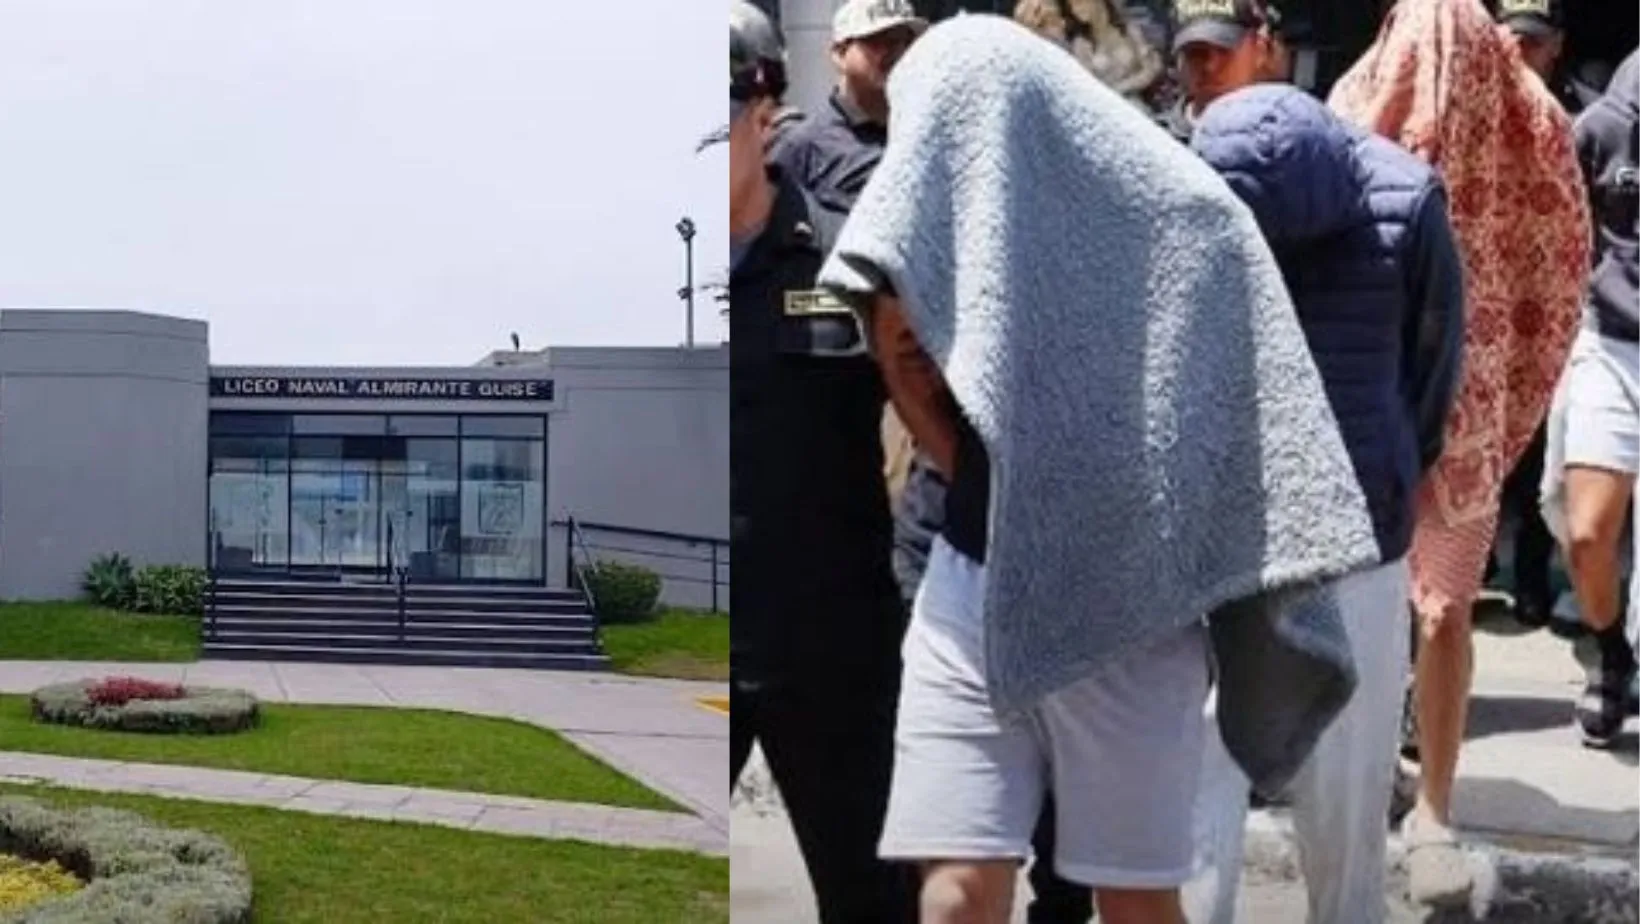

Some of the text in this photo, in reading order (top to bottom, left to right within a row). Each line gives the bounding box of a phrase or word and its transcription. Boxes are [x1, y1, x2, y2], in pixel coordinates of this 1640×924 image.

[224, 379, 279, 393] LICEO
[288, 380, 348, 394] NAVAL
[357, 381, 472, 396] ALMIRANTE
